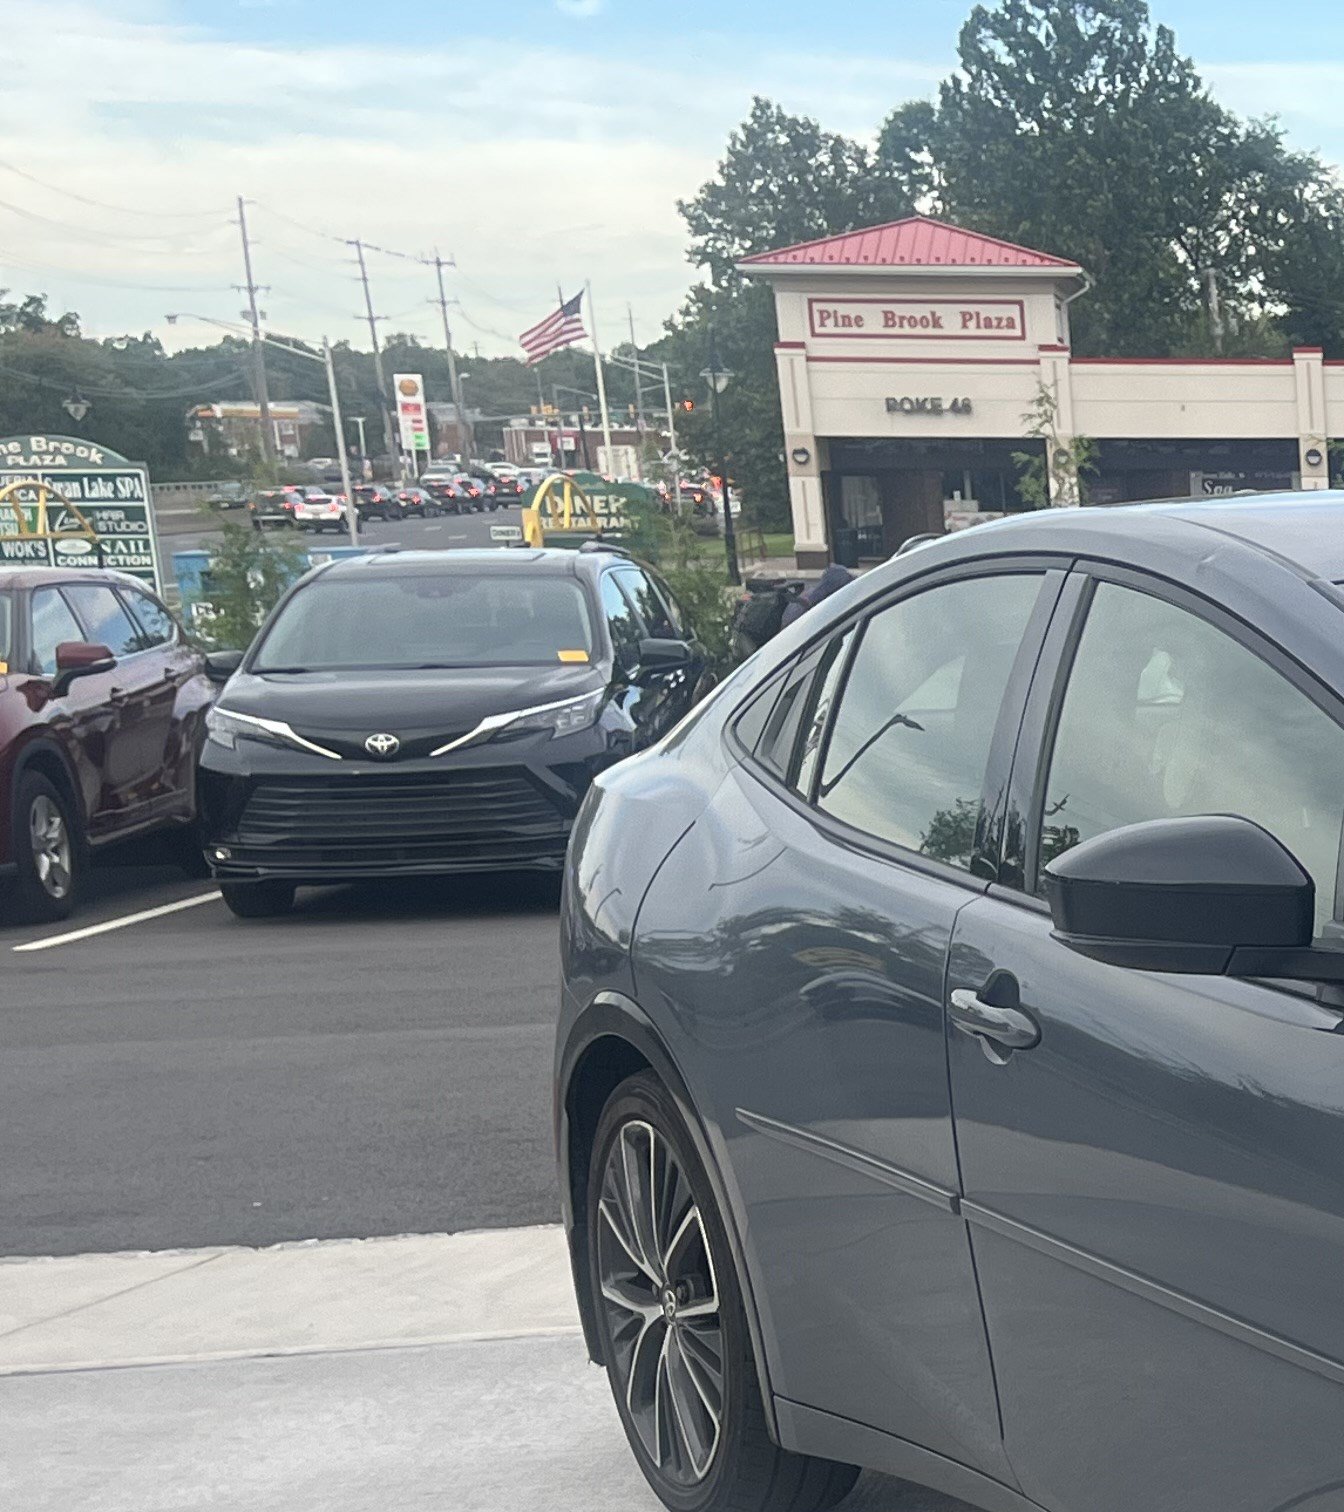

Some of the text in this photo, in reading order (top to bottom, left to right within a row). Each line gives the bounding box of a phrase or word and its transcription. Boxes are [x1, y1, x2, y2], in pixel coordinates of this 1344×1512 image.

[817, 309, 1017, 330] Pine Brook Plaza
[30, 436, 105, 465] Brook
[6, 455, 68, 467] PLAZA
[82, 477, 115, 500] Lake
[115, 477, 144, 499] SPA
[97, 521, 148, 533] STUDIO
[2, 541, 47, 558] WOK'S
[57, 555, 150, 567] CONNCTION
